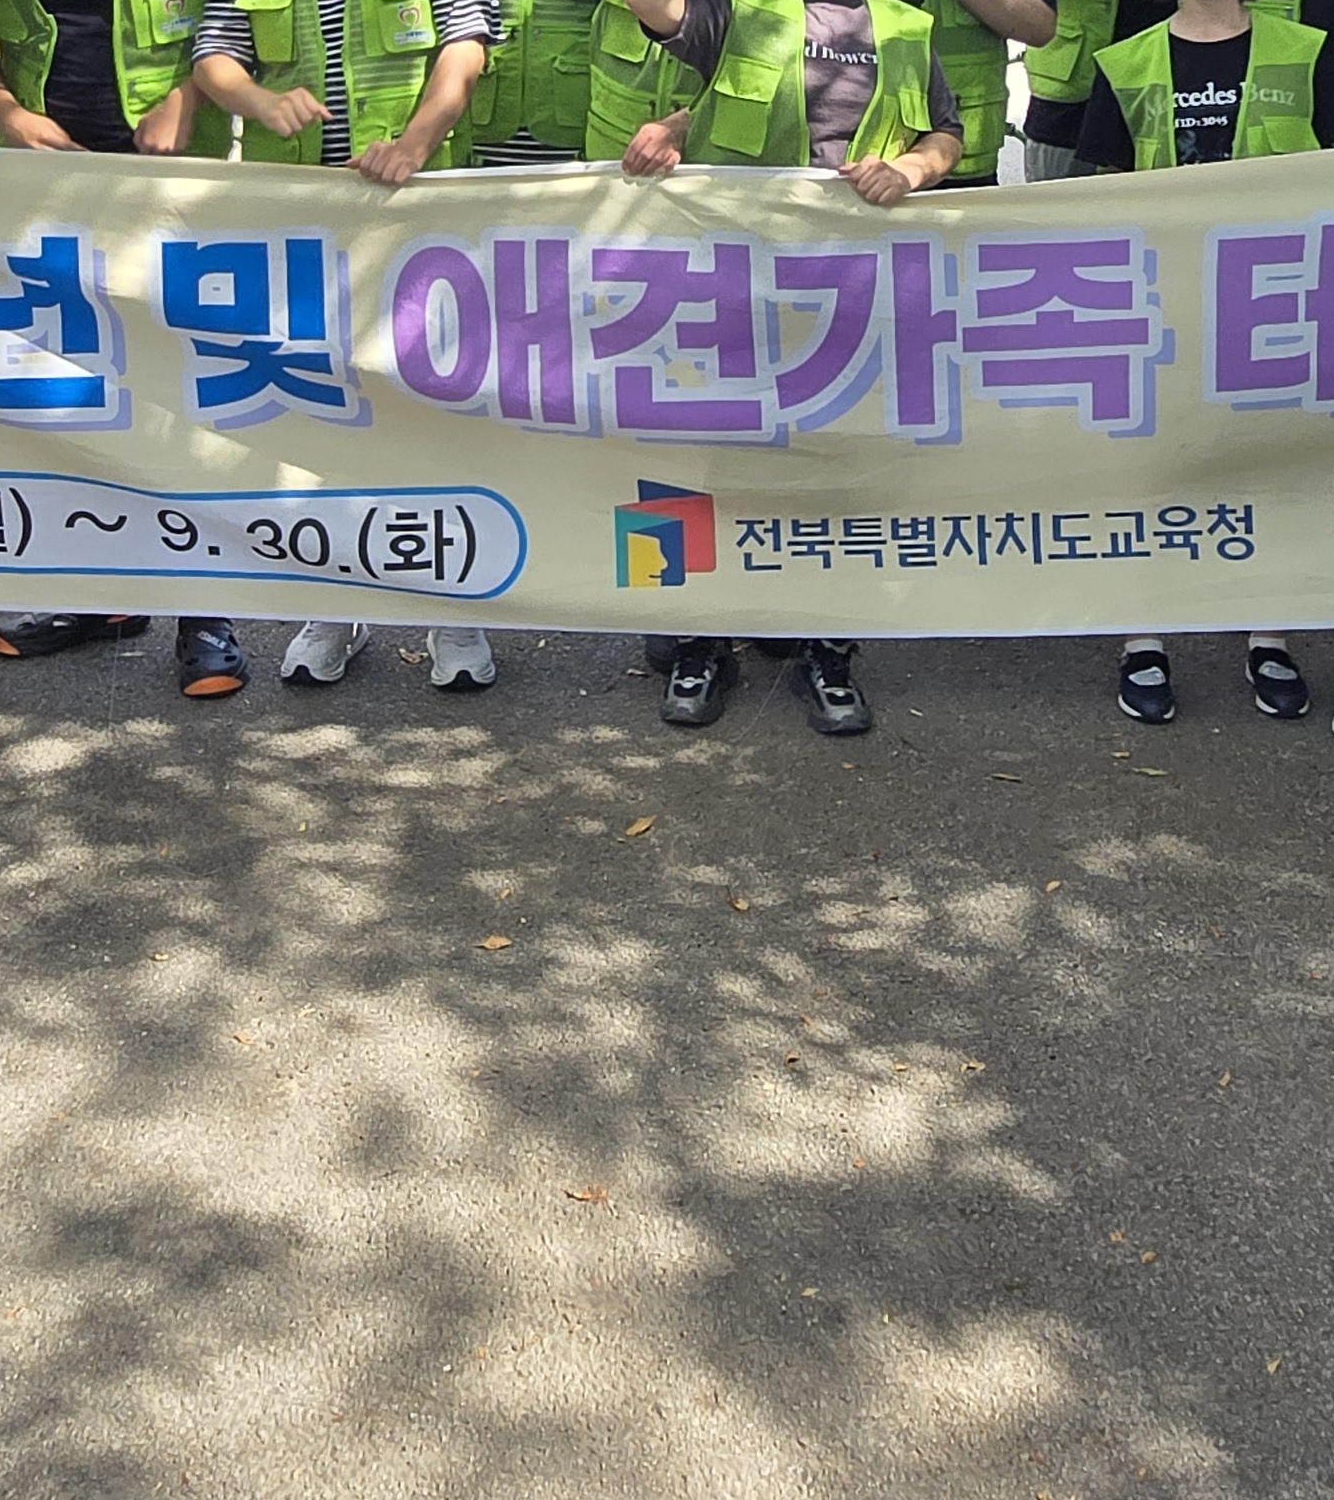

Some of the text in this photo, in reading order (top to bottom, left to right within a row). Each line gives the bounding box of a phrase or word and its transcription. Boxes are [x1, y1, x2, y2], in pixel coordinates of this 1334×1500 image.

[161, 237, 347, 411] 및
[393, 237, 1150, 431] 애견가족
[156, 509, 222, 557] 9.
[734, 503, 1256, 572] 전북특별자치도교육청
